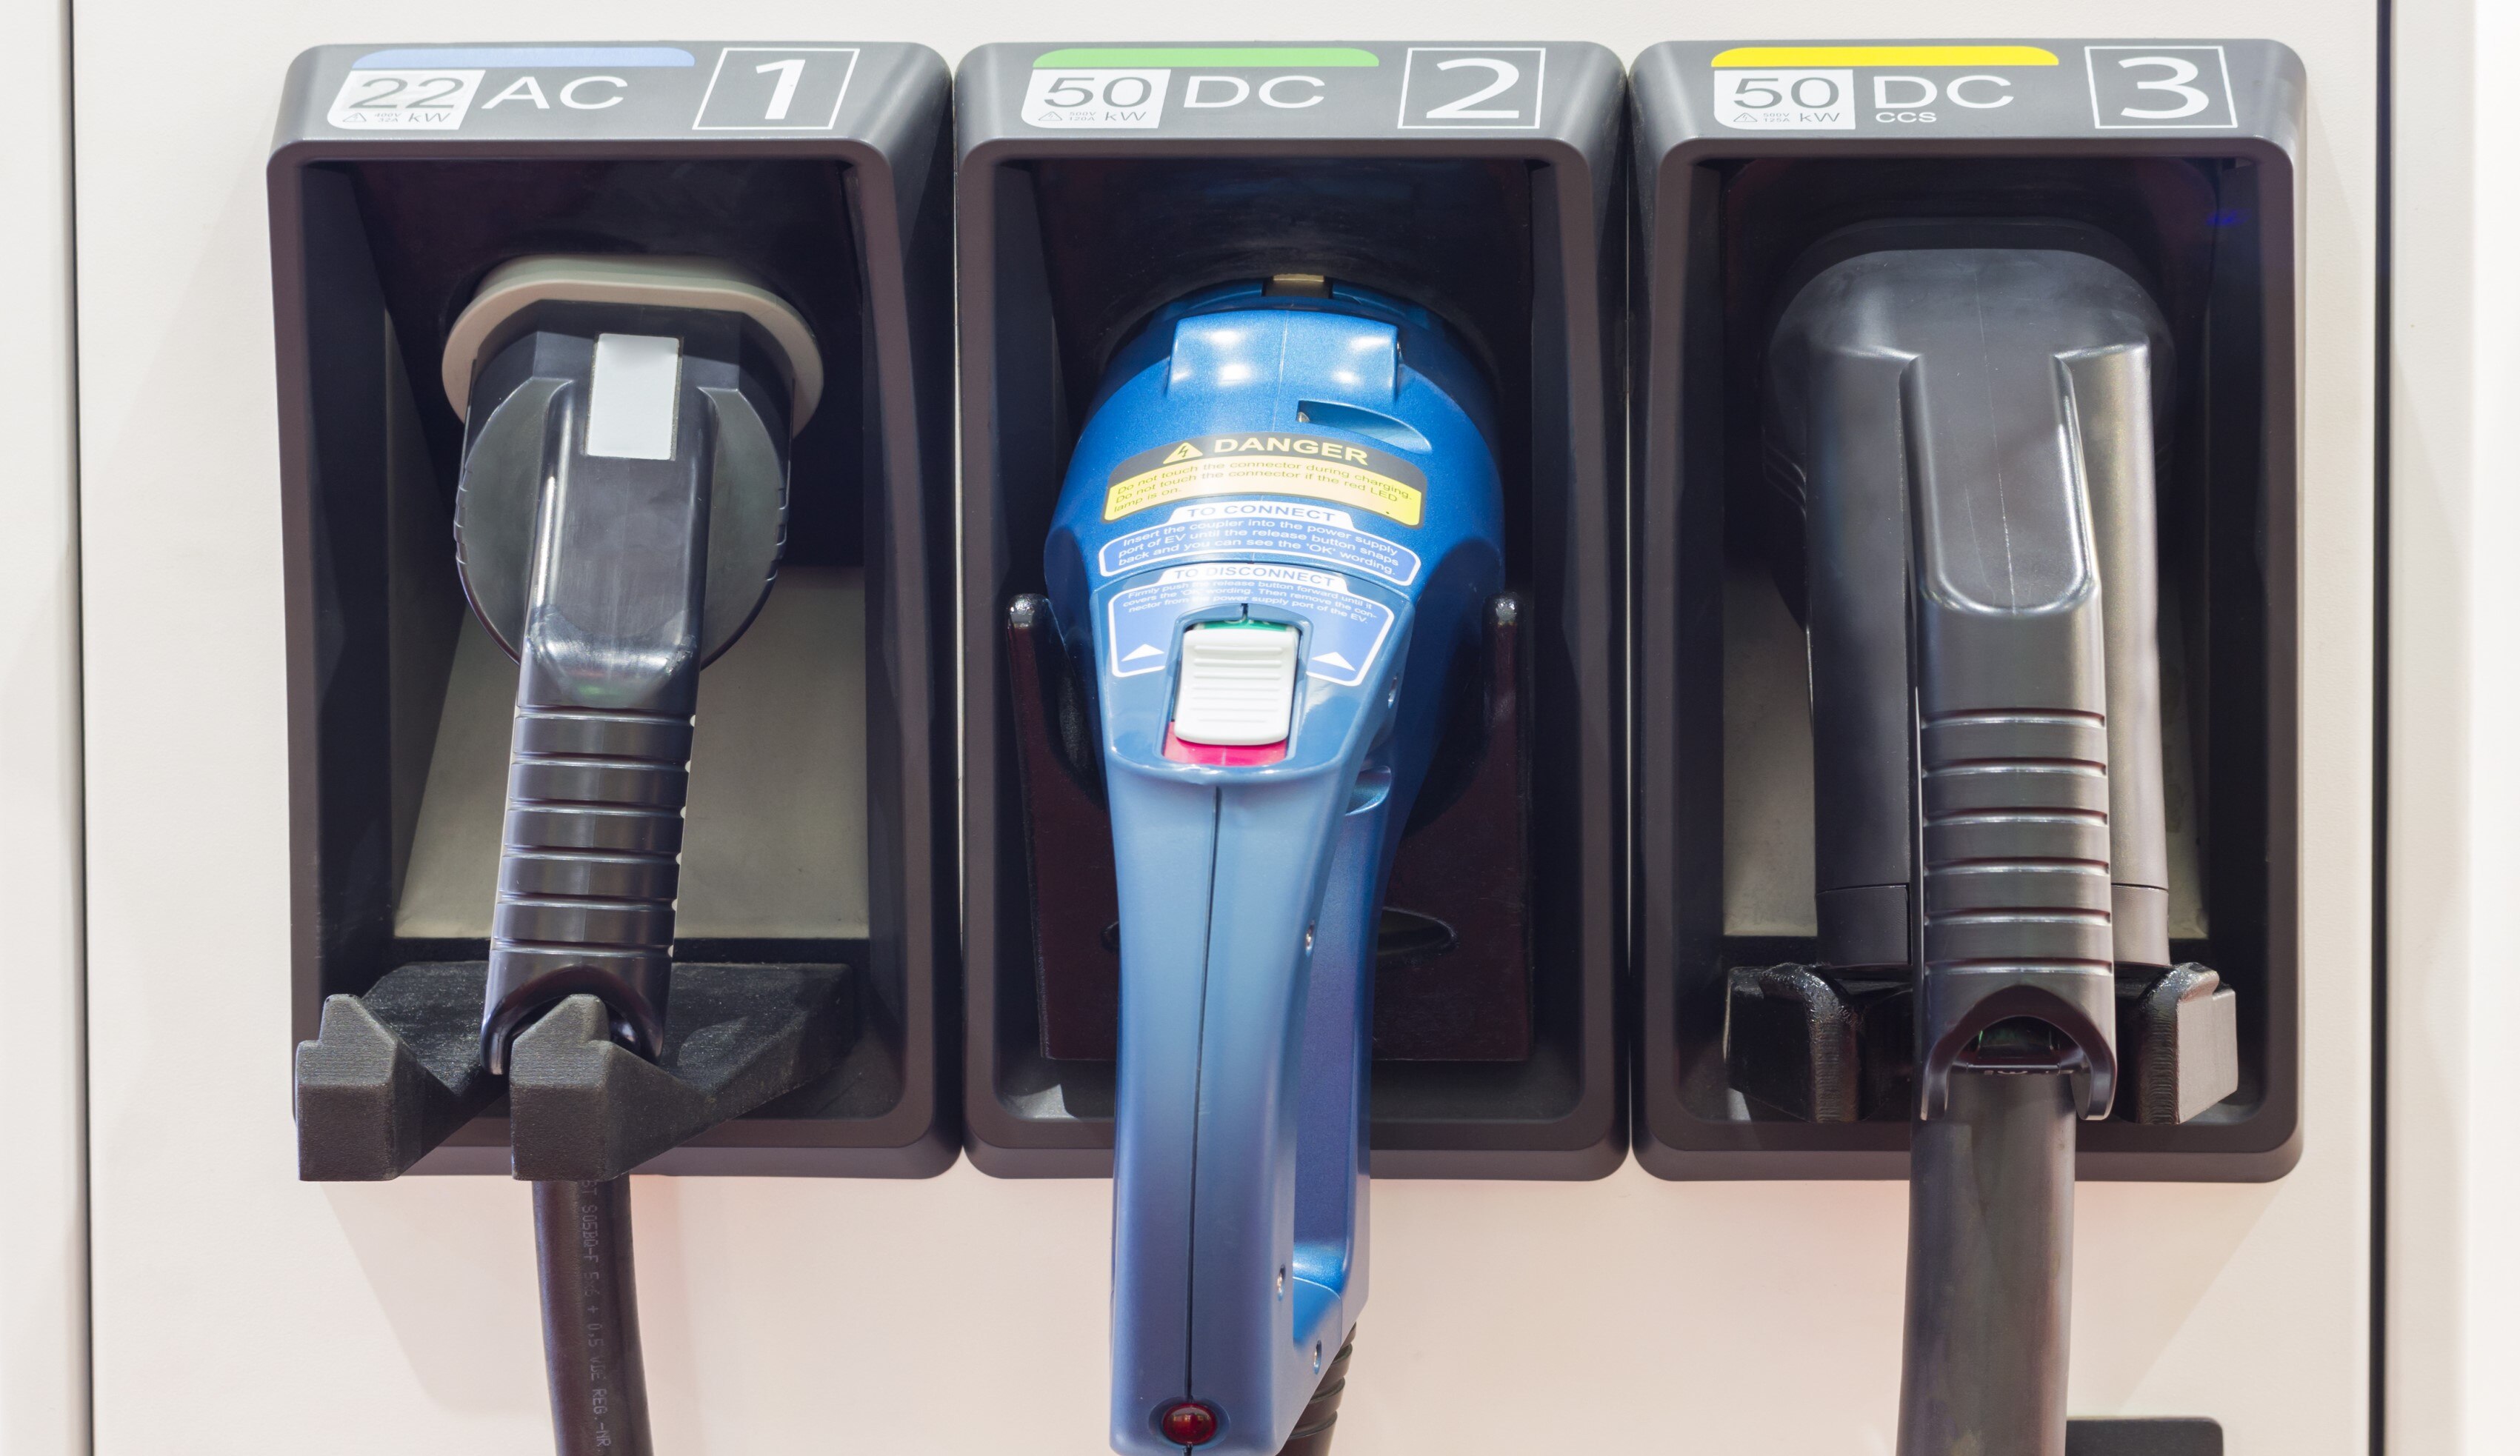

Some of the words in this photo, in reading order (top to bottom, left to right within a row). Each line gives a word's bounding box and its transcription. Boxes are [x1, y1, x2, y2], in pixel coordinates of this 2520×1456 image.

[348, 78, 464, 109] 22
[481, 76, 628, 110] AC
[756, 59, 806, 120] 1
[1044, 76, 1152, 107] 50
[1184, 75, 1326, 109] DC
[1426, 57, 1520, 119] 2
[1733, 77, 1839, 109] 50
[1873, 75, 2014, 109] DC
[2118, 56, 2210, 119] 3
[408, 113, 451, 122] kW
[1104, 112, 1147, 121] kW
[1800, 113, 1840, 122] kW
[1876, 112, 1938, 123] CCS
[1214, 437, 1368, 466] DANGER
[1116, 494, 1133, 504] Do
[1136, 484, 1156, 495] not
[1160, 473, 1196, 487] touch
[1201, 472, 1223, 480] the
[1229, 470, 1301, 478] connector
[1318, 475, 1339, 484] the
[1344, 481, 1366, 491] red
[1370, 487, 1398, 502] LED
[1117, 484, 1134, 495] Do
[1138, 475, 1158, 486] not
[1161, 466, 1198, 478] touch
[1203, 463, 1224, 471] the
[1230, 461, 1301, 470] connector
[1306, 464, 1350, 478] during
[1354, 474, 1412, 500] charging.
[1114, 498, 1143, 512] lamp
[1161, 487, 1181, 496] on.
[1187, 507, 1216, 518] TO
[1224, 505, 1336, 521] CONNECT
[1118, 543, 1144, 558] port
[1147, 538, 1161, 548] of
[1164, 534, 1185, 544] EV
[1190, 530, 1219, 539] until
[1252, 530, 1307, 541] release
[1311, 535, 1356, 550] button
[1360, 548, 1399, 566] snaps
[1123, 530, 1160, 547] Insert
[1163, 526, 1184, 535] the
[1190, 519, 1244, 530] coupler
[1248, 519, 1275, 527] into
[1280, 521, 1303, 530] the
[1307, 525, 1351, 539] power
[1355, 536, 1398, 556] supply
[1118, 551, 1150, 566] back
[1153, 544, 1179, 555] and
[1184, 541, 1210, 551] you
[1278, 541, 1301, 550] the
[1339, 551, 1396, 575] wording.
[1175, 568, 1198, 579] TO
[1206, 567, 1335, 587] DISCONNECT
[1123, 595, 1156, 607] covers
[1181, 587, 1203, 595] 'OK
[1259, 588, 1287, 597] Then
[1290, 593, 1332, 605] remove
[1335, 602, 1351, 610] the
[1354, 608, 1377, 618] con-
[1127, 587, 1160, 598] Firmly
[1161, 584, 1189, 592] push
[1258, 581, 1293, 590] button
[1297, 585, 1339, 599] forward
[1341, 595, 1363, 607] until
[1128, 601, 1161, 612] nector
[1251, 595, 1289, 606] supply
[1292, 600, 1314, 609] port
[1330, 608, 1347, 617] the
[1350, 613, 1367, 624] EV.
